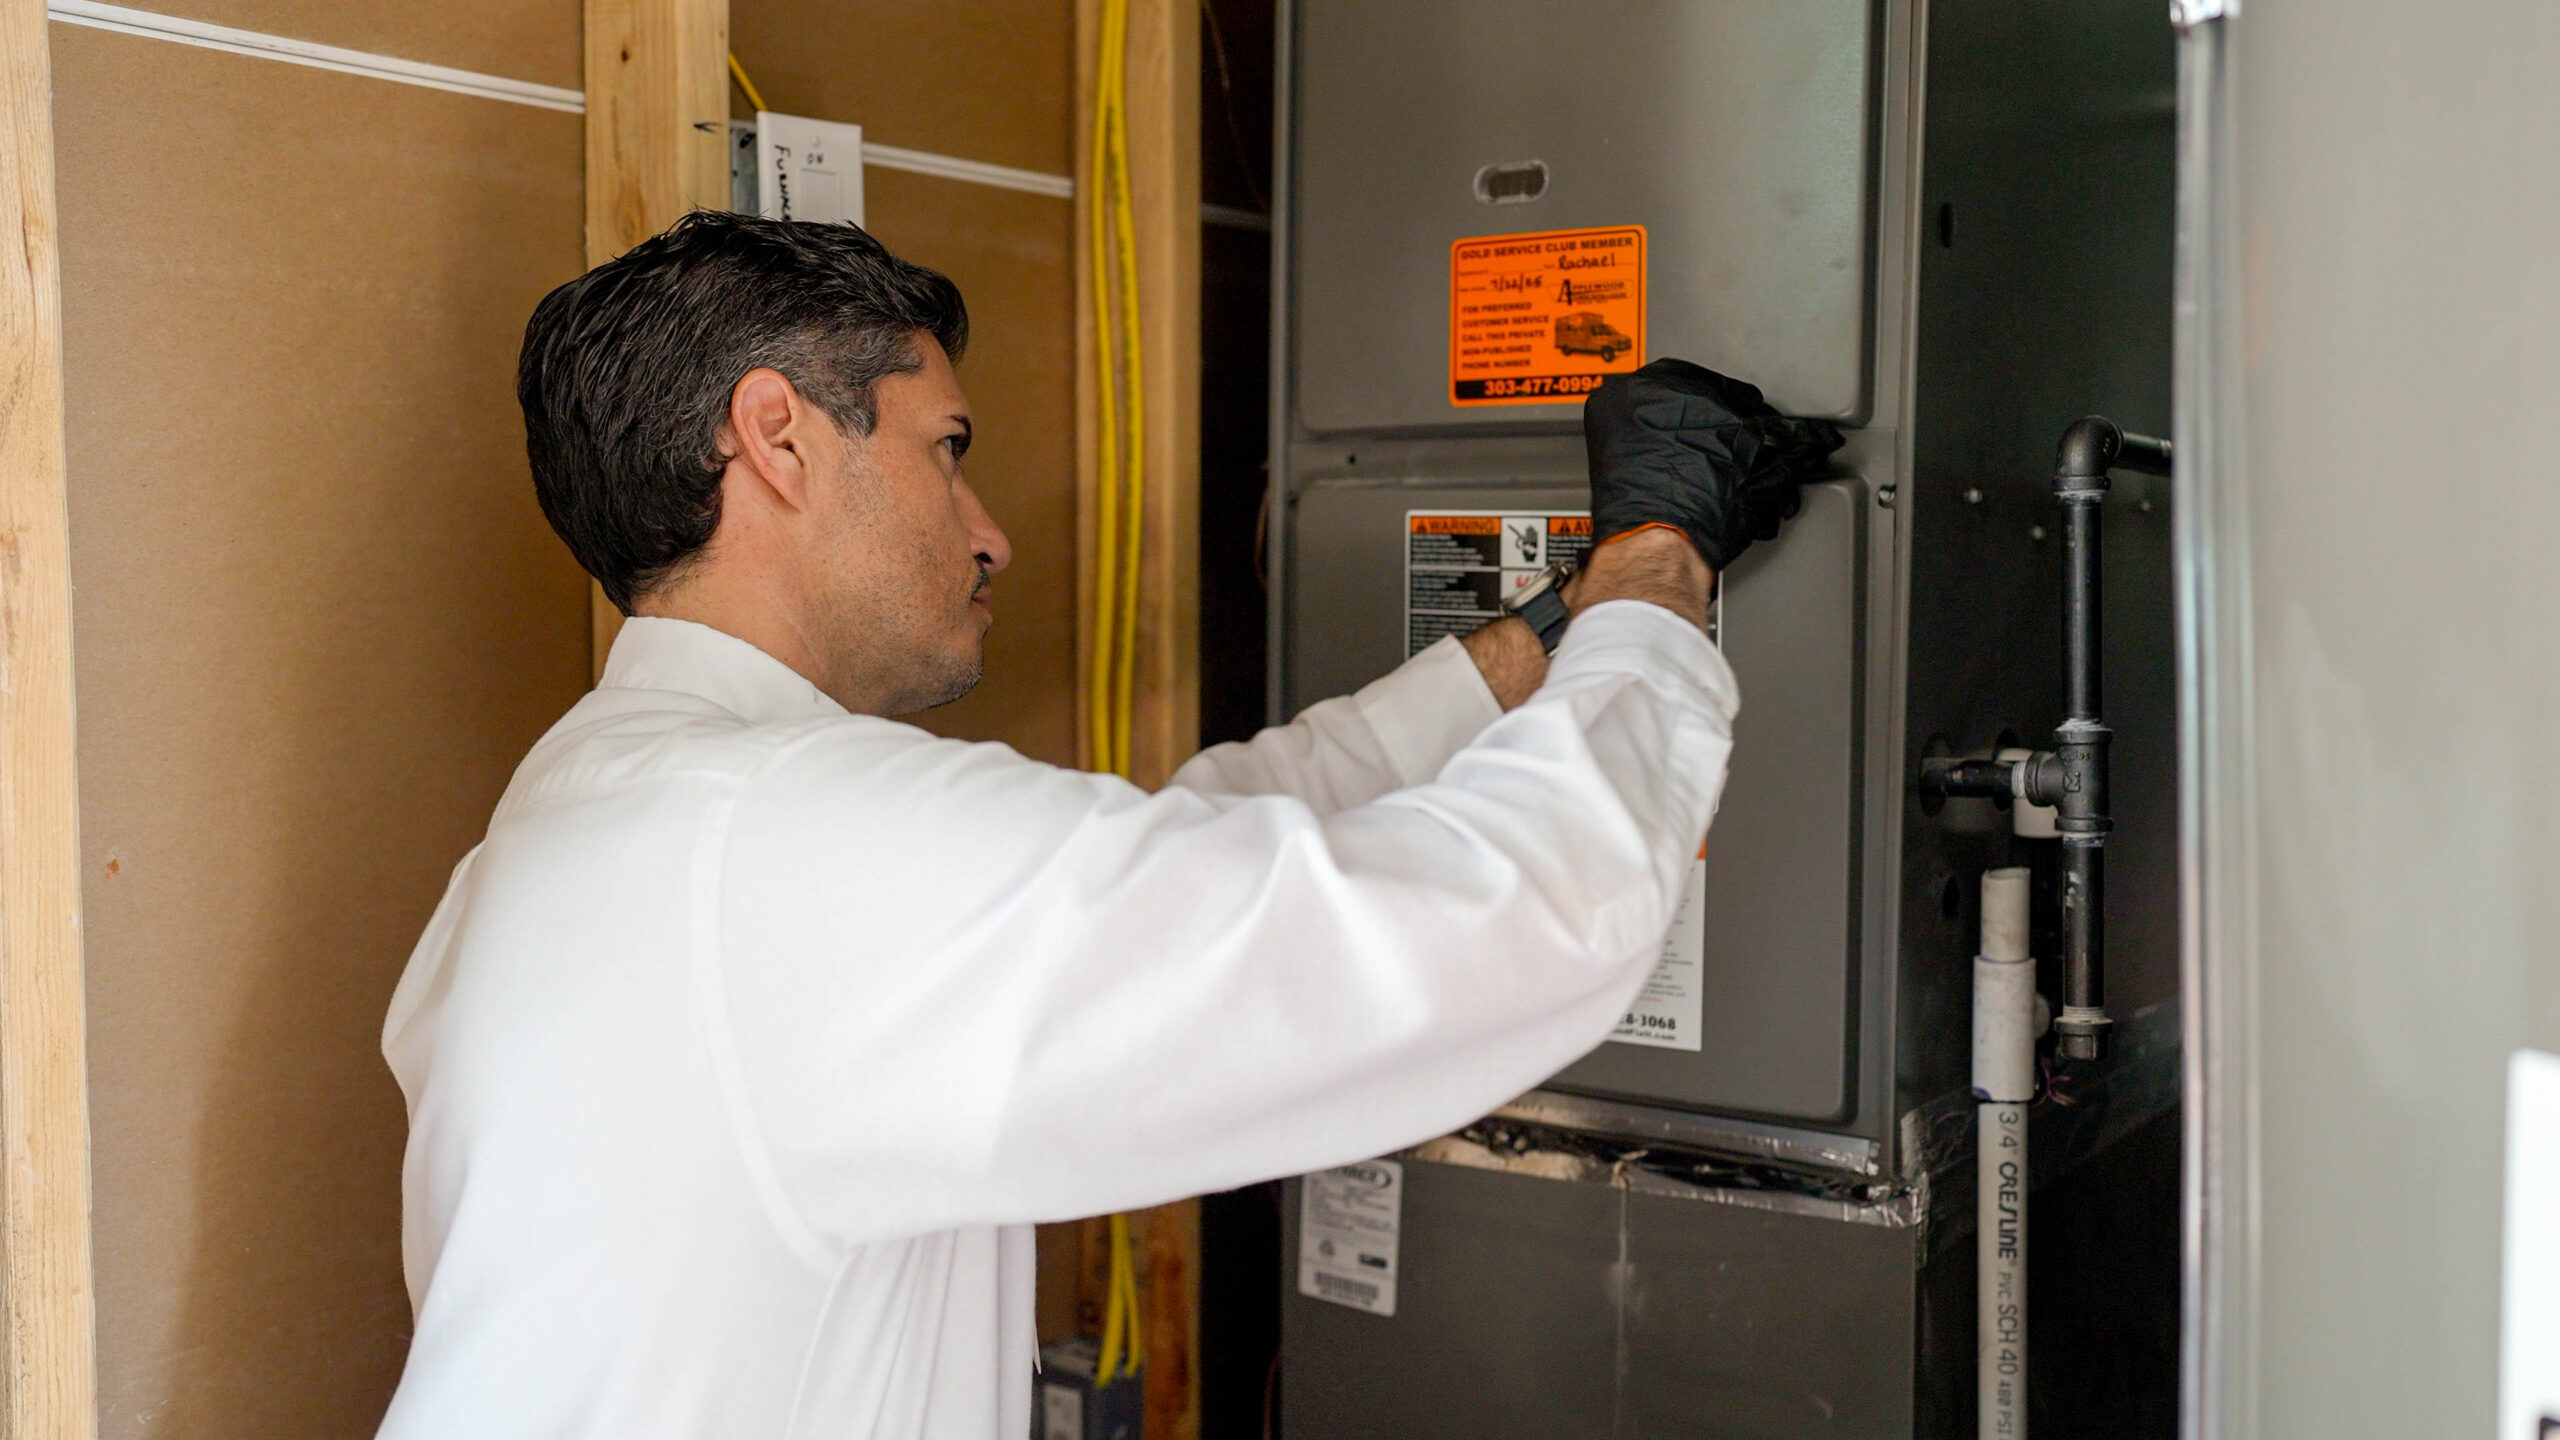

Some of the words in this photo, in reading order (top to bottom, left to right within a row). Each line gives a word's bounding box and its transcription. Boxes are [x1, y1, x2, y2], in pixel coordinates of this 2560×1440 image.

[1460, 249, 1490, 260] GOLD
[1494, 244, 1541, 257] SERVICE
[1545, 241, 1576, 253] CLUB
[1580, 237, 1633, 249] MEMBER
[1558, 252, 1615, 270] Rachael
[1462, 305, 1479, 314] FOR
[1481, 302, 1532, 312] PREFERRED
[1462, 318, 1508, 328] CUSTOMER
[1512, 315, 1548, 325] SERVICE
[1462, 333, 1482, 342] CALL
[1486, 332, 1506, 340] THIS
[1508, 329, 1545, 338] PRIVATE
[1462, 345, 1532, 356] NON-PUBLISHED
[1462, 362, 1490, 370] PHONE
[1494, 359, 1531, 368] NUMBER
[1430, 518, 1495, 533] WARNING
[1998, 1272, 2012, 1299] PVC
[1998, 1304, 2018, 1343] SCH
[1998, 1350, 2018, 1375] 40
[1998, 1411, 2012, 1434] PSI
